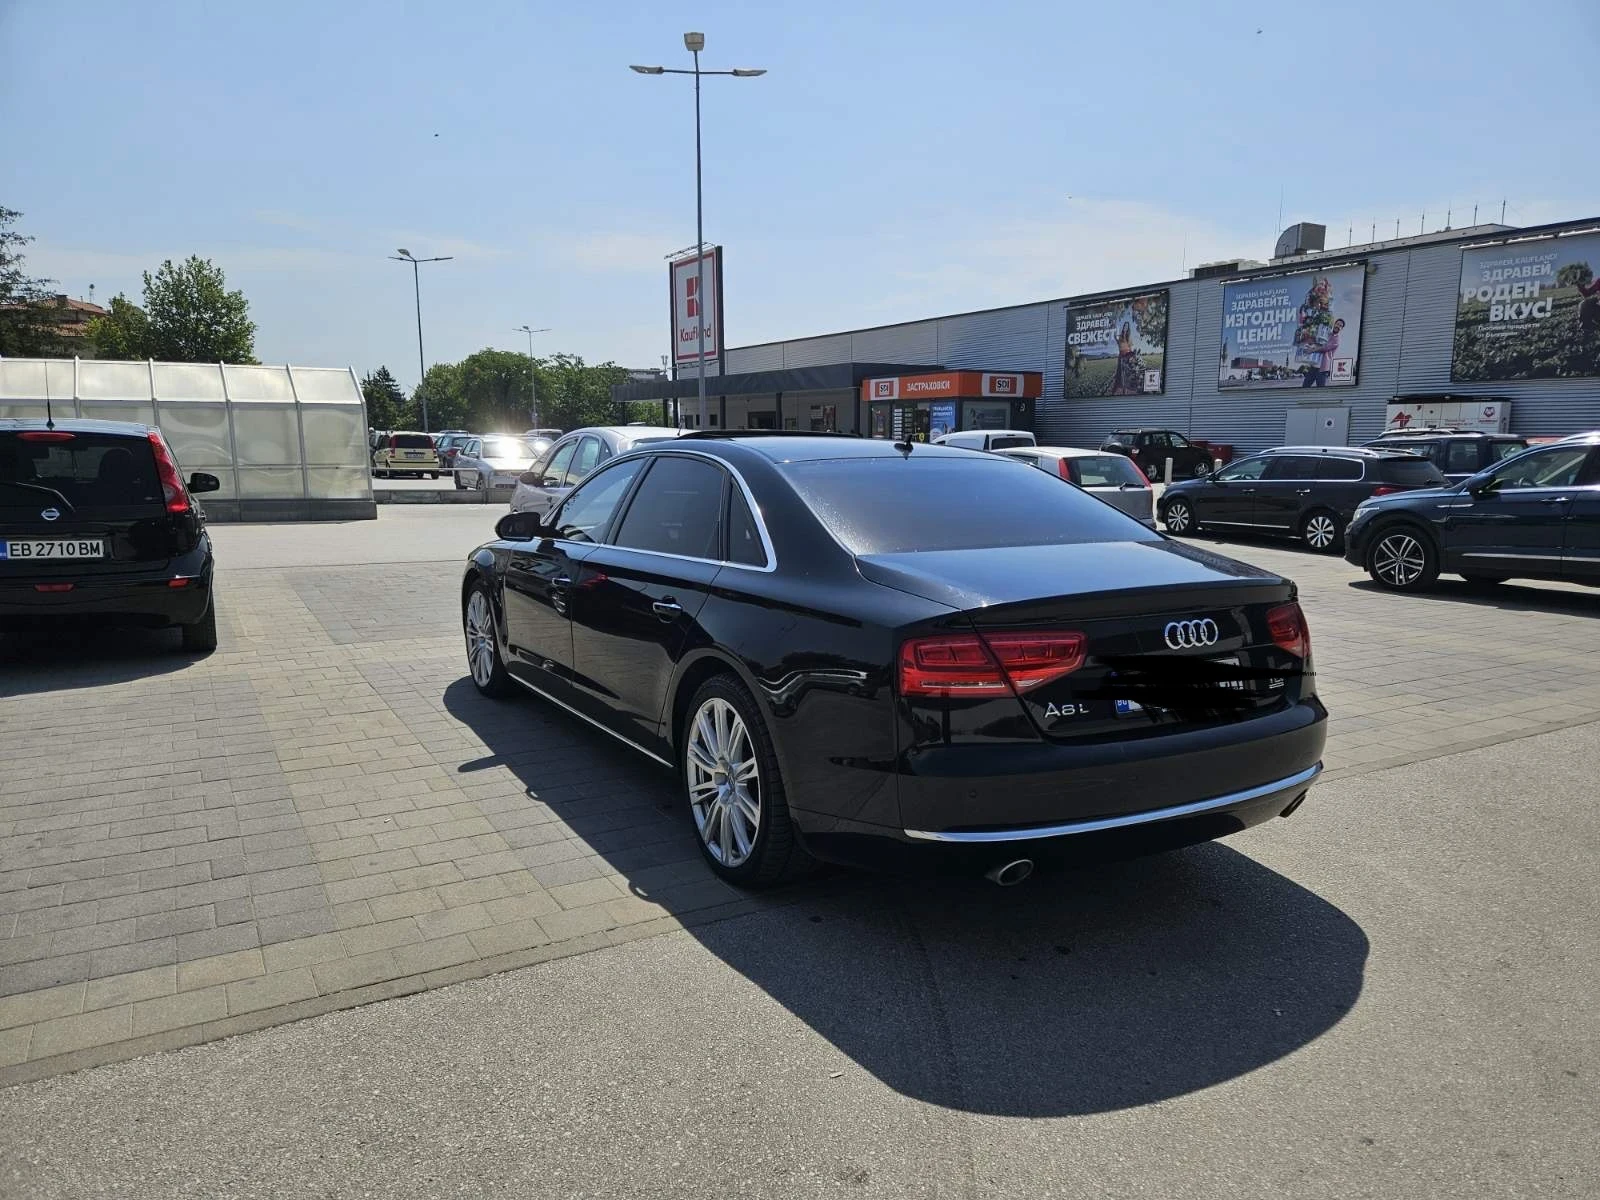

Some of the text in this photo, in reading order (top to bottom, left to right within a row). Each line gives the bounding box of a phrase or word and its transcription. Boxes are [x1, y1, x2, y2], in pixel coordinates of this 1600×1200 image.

[1483, 261, 1554, 283] ЗДРАВЕЙ,
[1463, 280, 1540, 304] РОДЕН
[1232, 295, 1292, 312] ЗДРАВЕЙТЕ,
[1489, 297, 1553, 322] ВКУС!
[1076, 316, 1111, 331] ЗДРАВЕЙ,
[1226, 307, 1297, 328] ИЗГОДНИ
[680, 323, 711, 342] Kauflnd
[1237, 323, 1283, 346] ЦЕНИ!
[997, 380, 1010, 389] SDI
[10, 542, 100, 557] EB 2710 BM
